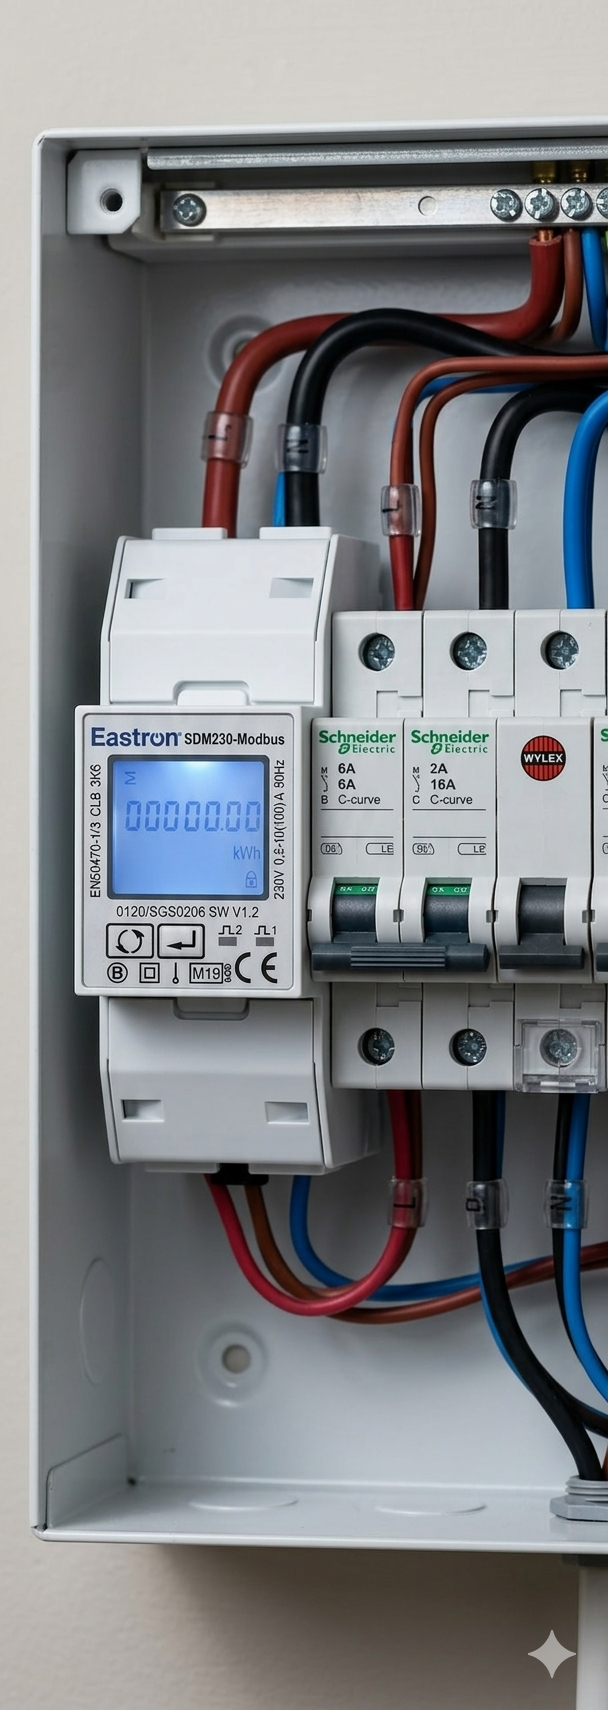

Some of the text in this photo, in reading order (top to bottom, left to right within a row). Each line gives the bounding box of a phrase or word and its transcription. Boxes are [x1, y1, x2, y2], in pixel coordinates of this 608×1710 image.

[91, 727, 285, 747] Eastron SDM230-Modbus
[318, 730, 396, 744] Schneider
[411, 730, 489, 744] Schneider
[523, 753, 564, 763] WYLEX
[320, 766, 328, 774] M
[337, 762, 356, 774] 6A
[412, 766, 420, 774] M
[430, 762, 448, 774] 2A
[90, 764, 101, 787] 3K6
[337, 778, 356, 790] 6A
[430, 778, 456, 790] 16A
[320, 794, 381, 805] B C-curve
[412, 794, 473, 805] C C-curve
[125, 801, 260, 832] 00000.00
[233, 845, 260, 860] kWh
[116, 905, 259, 918] 0120/SGS0206 SW V1.2
[235, 925, 242, 935] 2
[272, 926, 277, 935] 1
[112, 967, 123, 980] B
[192, 967, 221, 980] M19
[393, 1197, 416, 1209] L
